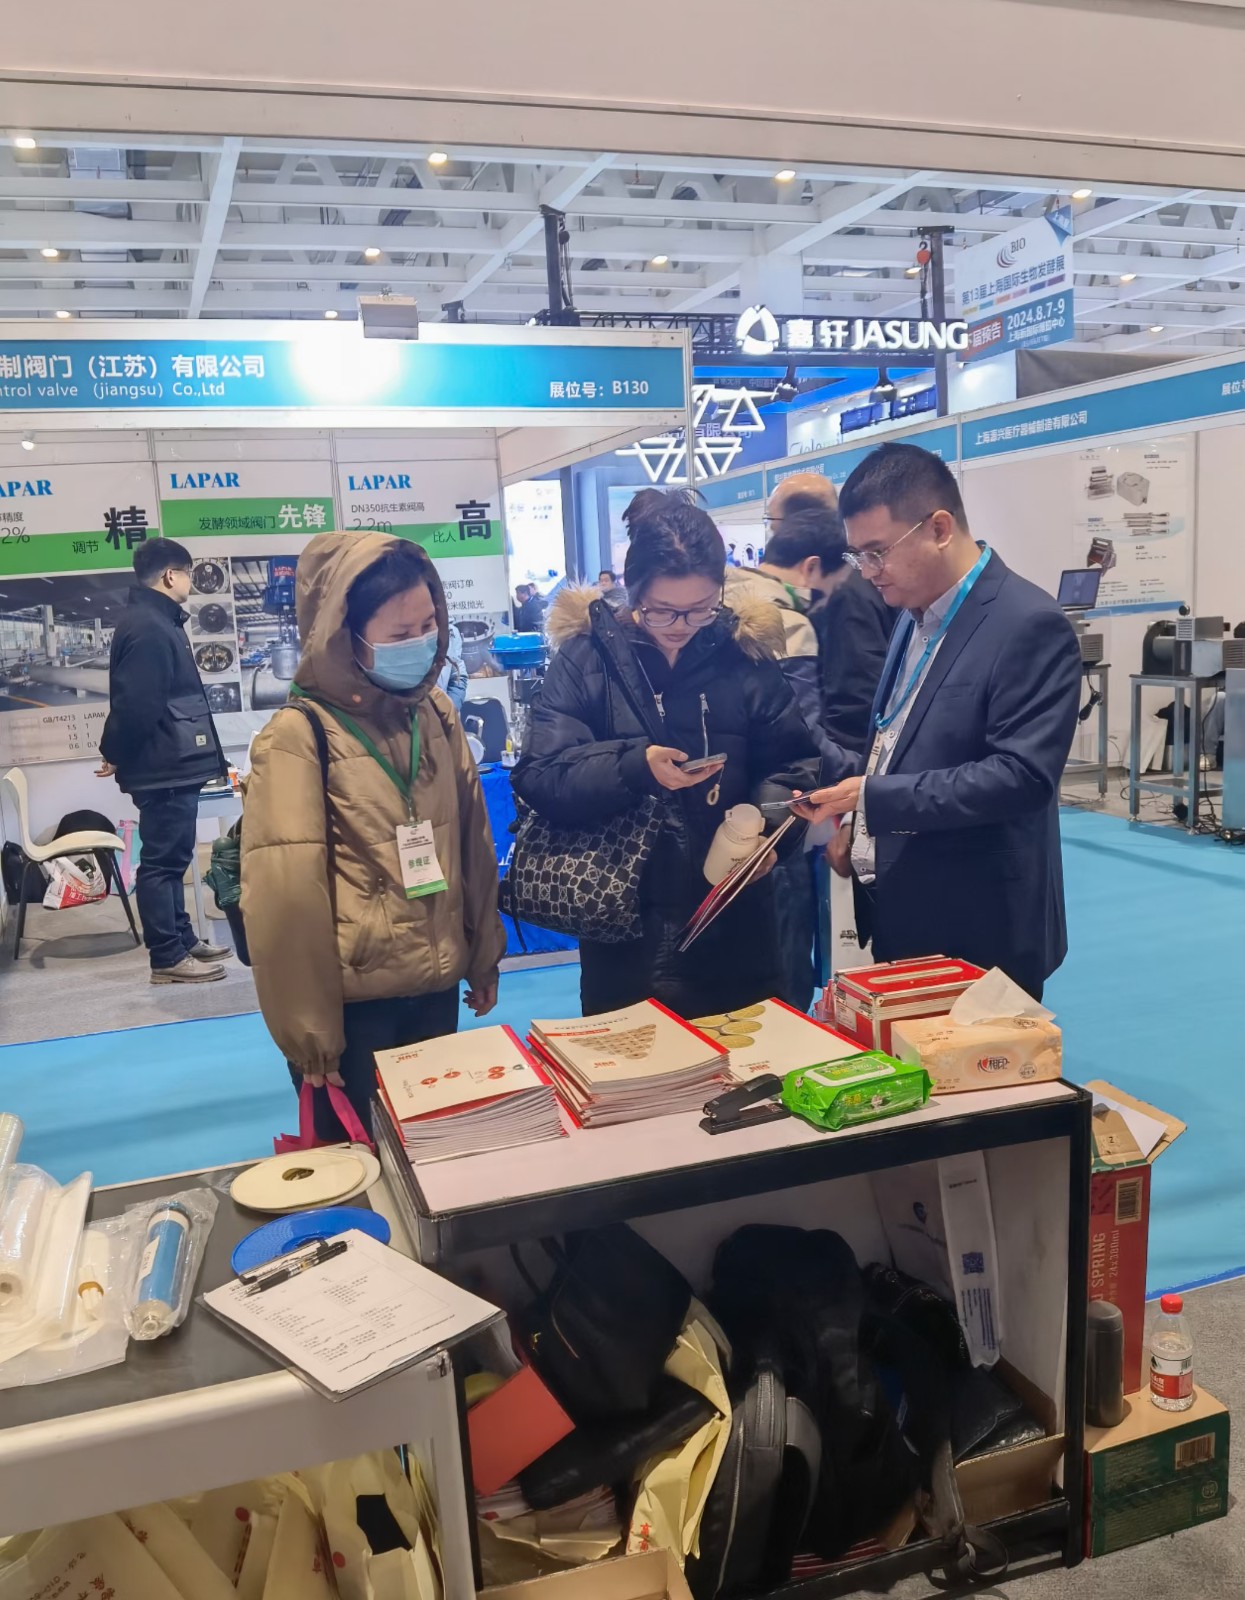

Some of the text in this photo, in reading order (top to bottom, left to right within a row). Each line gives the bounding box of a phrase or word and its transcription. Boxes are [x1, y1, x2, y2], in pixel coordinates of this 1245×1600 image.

[1010, 238, 1026, 253] BIO
[1007, 298, 1065, 331] 2024.8.7-9
[850, 318, 969, 350] JASUNG
[0, 382, 32, 397] trol
[37, 382, 78, 397] valve
[172, 381, 225, 397] Co.,Ltd
[170, 472, 241, 489] LAPAR
[348, 473, 413, 491] LAPAR
[71, 505, 149, 554] 调节 精
[198, 503, 327, 531] 发酵领域阀门 先锋
[433, 531, 457, 543] 比人
[455, 499, 491, 541] 高
[83, 711, 106, 720] LAPAR
[1091, 1232, 1106, 1289] SPRING
